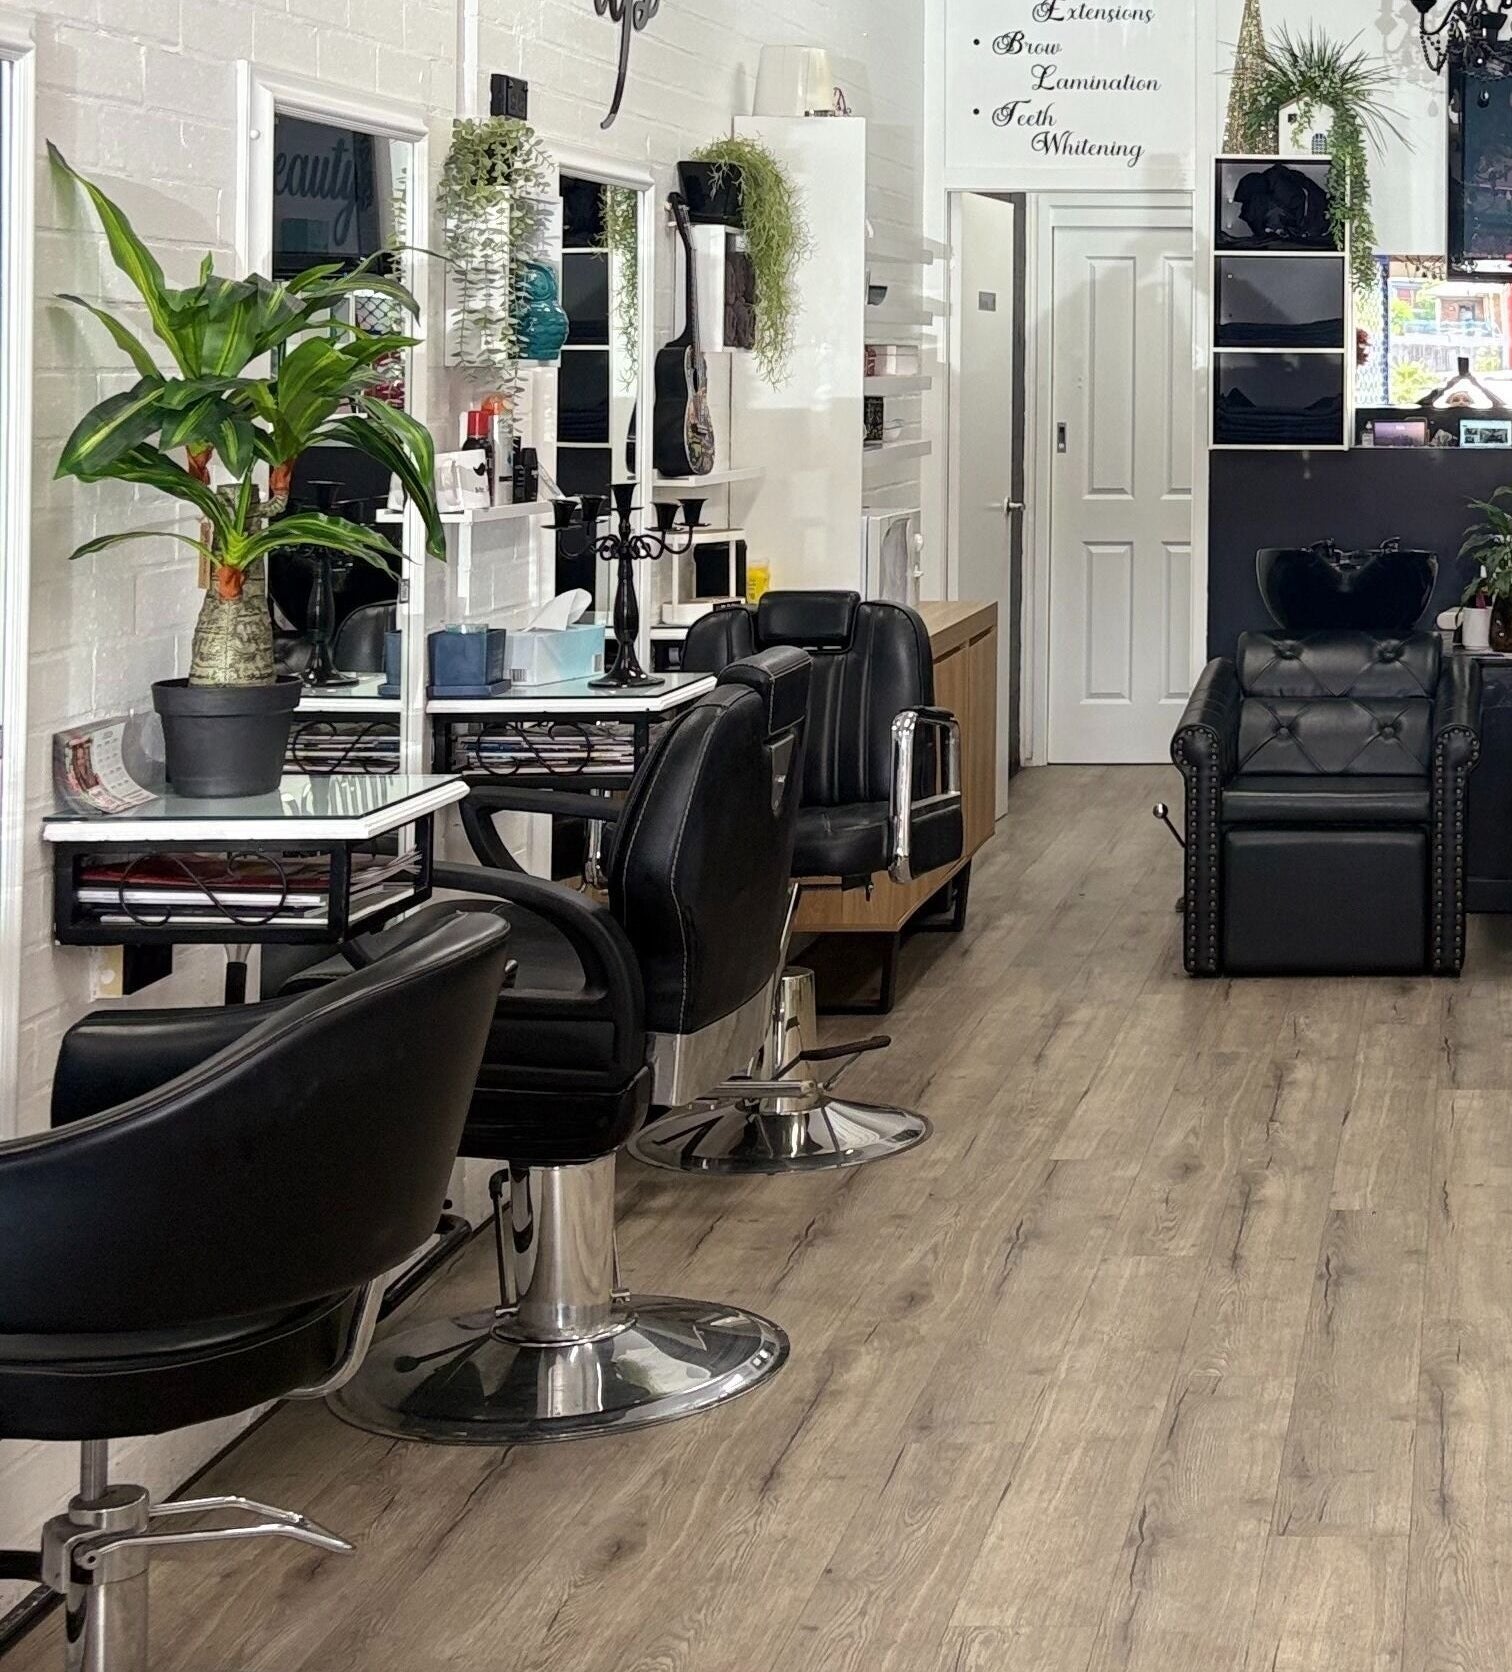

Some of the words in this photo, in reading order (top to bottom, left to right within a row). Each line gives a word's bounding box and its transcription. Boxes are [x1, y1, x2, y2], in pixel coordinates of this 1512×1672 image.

[1032, 0, 1154, 23] Extensions
[992, 30, 1062, 55] Brow
[1031, 63, 1161, 91] Lamination
[992, 99, 1057, 127] Teeth
[1031, 130, 1145, 168] Whitening
